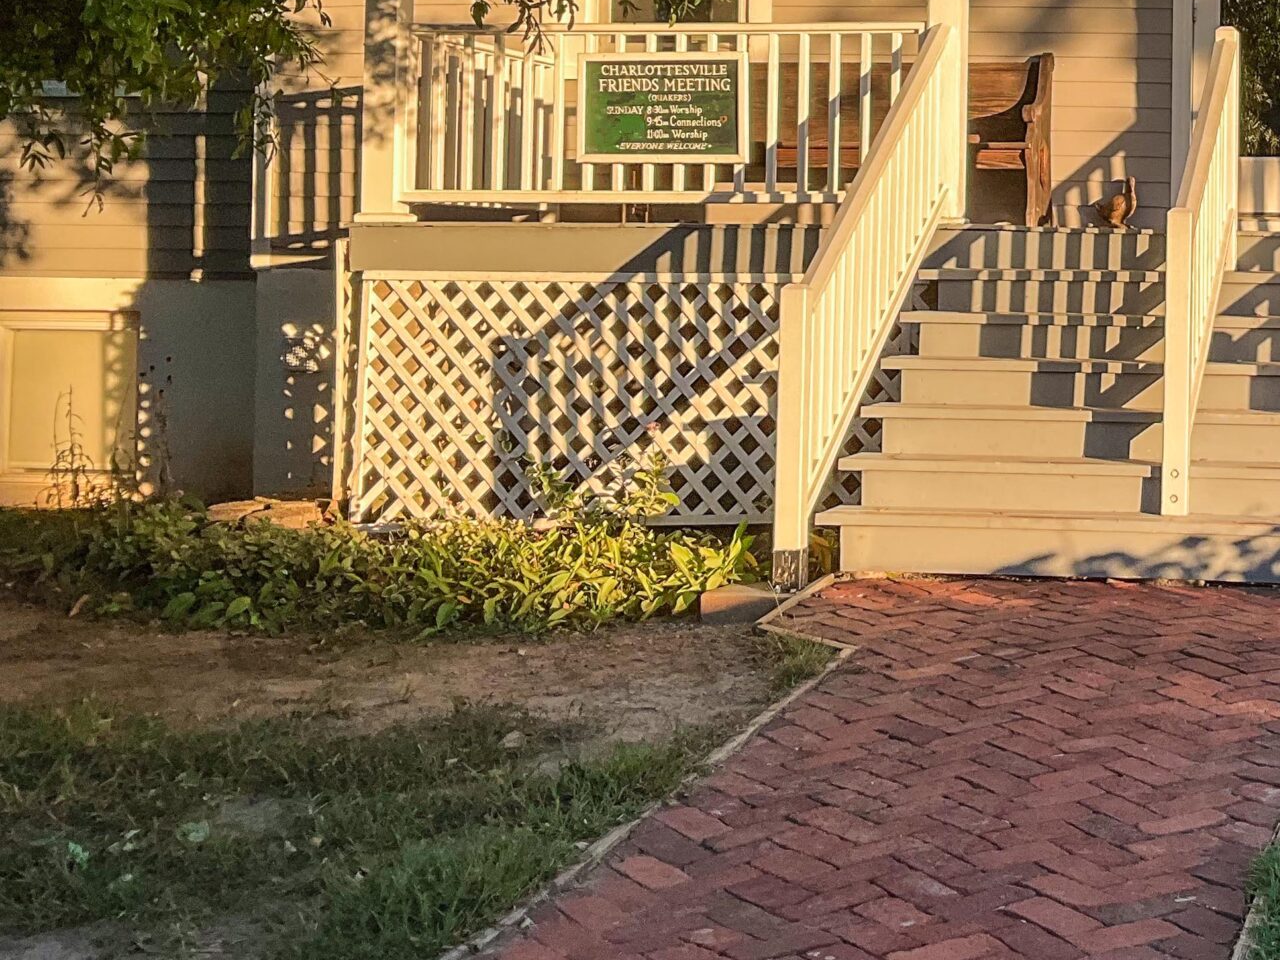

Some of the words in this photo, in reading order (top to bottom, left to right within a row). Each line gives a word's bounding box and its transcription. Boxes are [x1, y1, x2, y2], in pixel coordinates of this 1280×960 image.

[601, 64, 728, 76] CHARLOTTESVILLE
[599, 78, 660, 92] FRIENDS
[664, 78, 732, 91] MEETING
[647, 93, 692, 103] (QUAKERS)
[606, 105, 645, 115] SUNDAY
[669, 105, 703, 116] Worship
[669, 115, 722, 127] Connections
[672, 129, 709, 140] Worship
